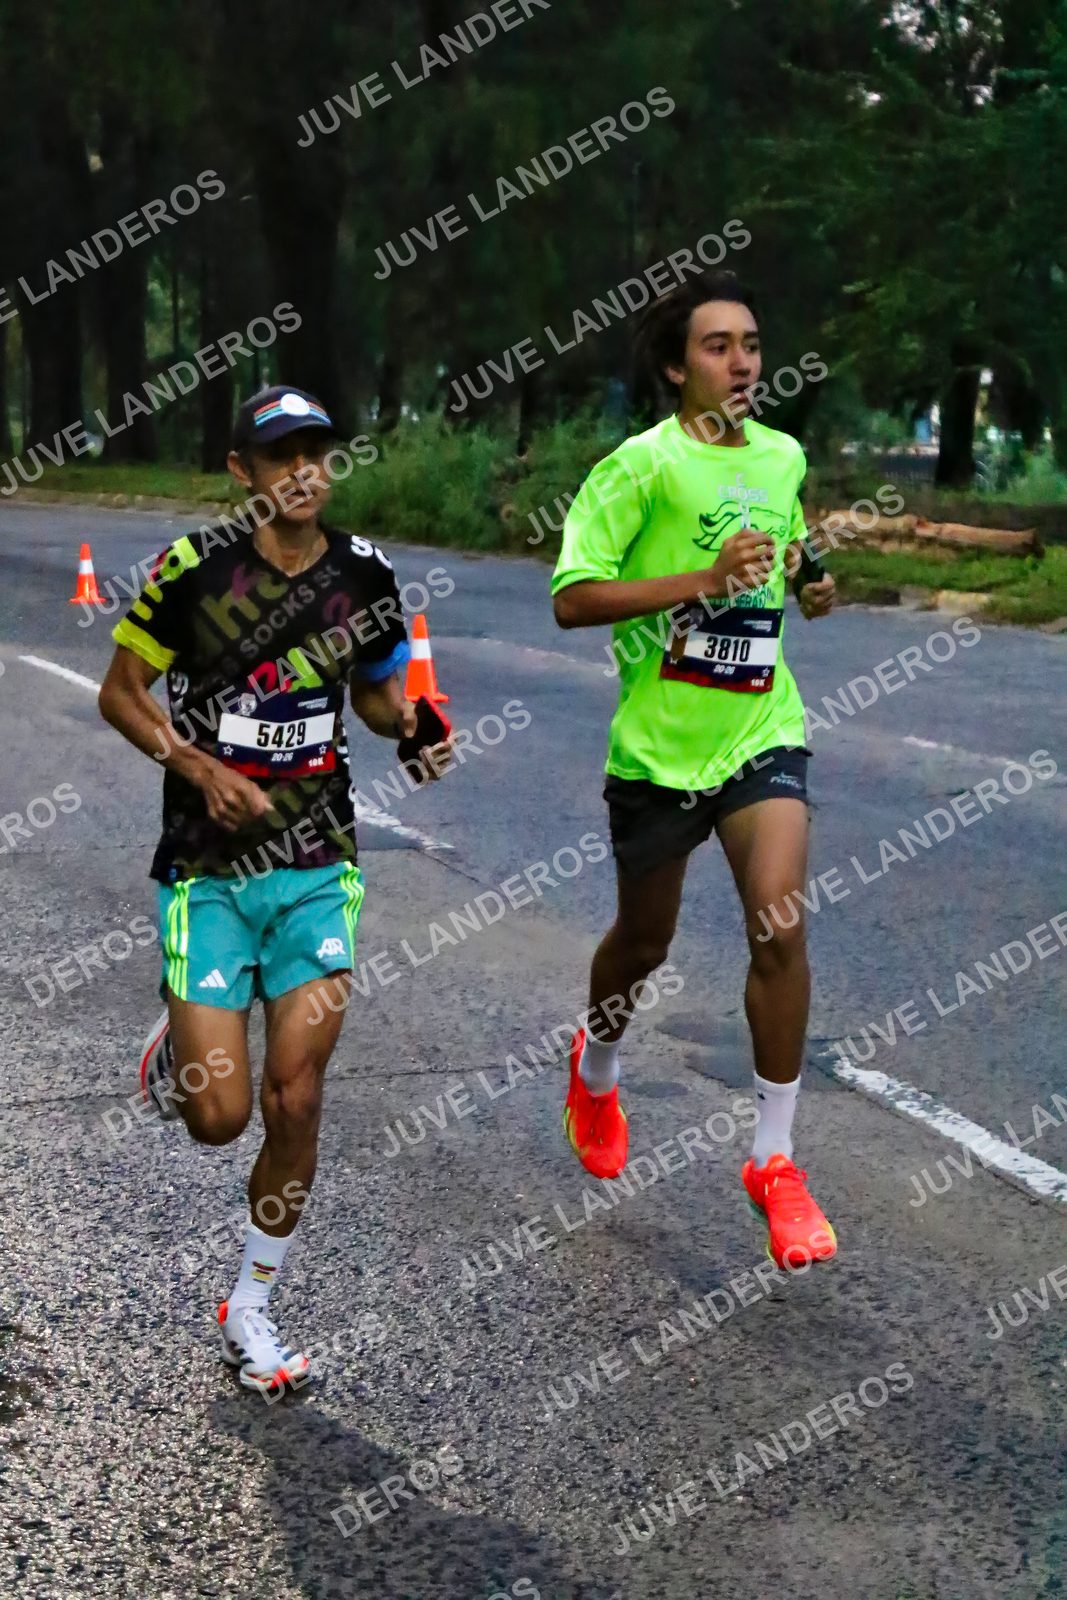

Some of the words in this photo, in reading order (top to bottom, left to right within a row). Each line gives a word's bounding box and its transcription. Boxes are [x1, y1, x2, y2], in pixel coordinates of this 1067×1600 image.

[718, 485, 769, 502] CROSS
[239, 583, 316, 659] SOCKS
[704, 635, 752, 662] 3810
[256, 720, 307, 748] 5429
[308, 757, 324, 767] 10K
